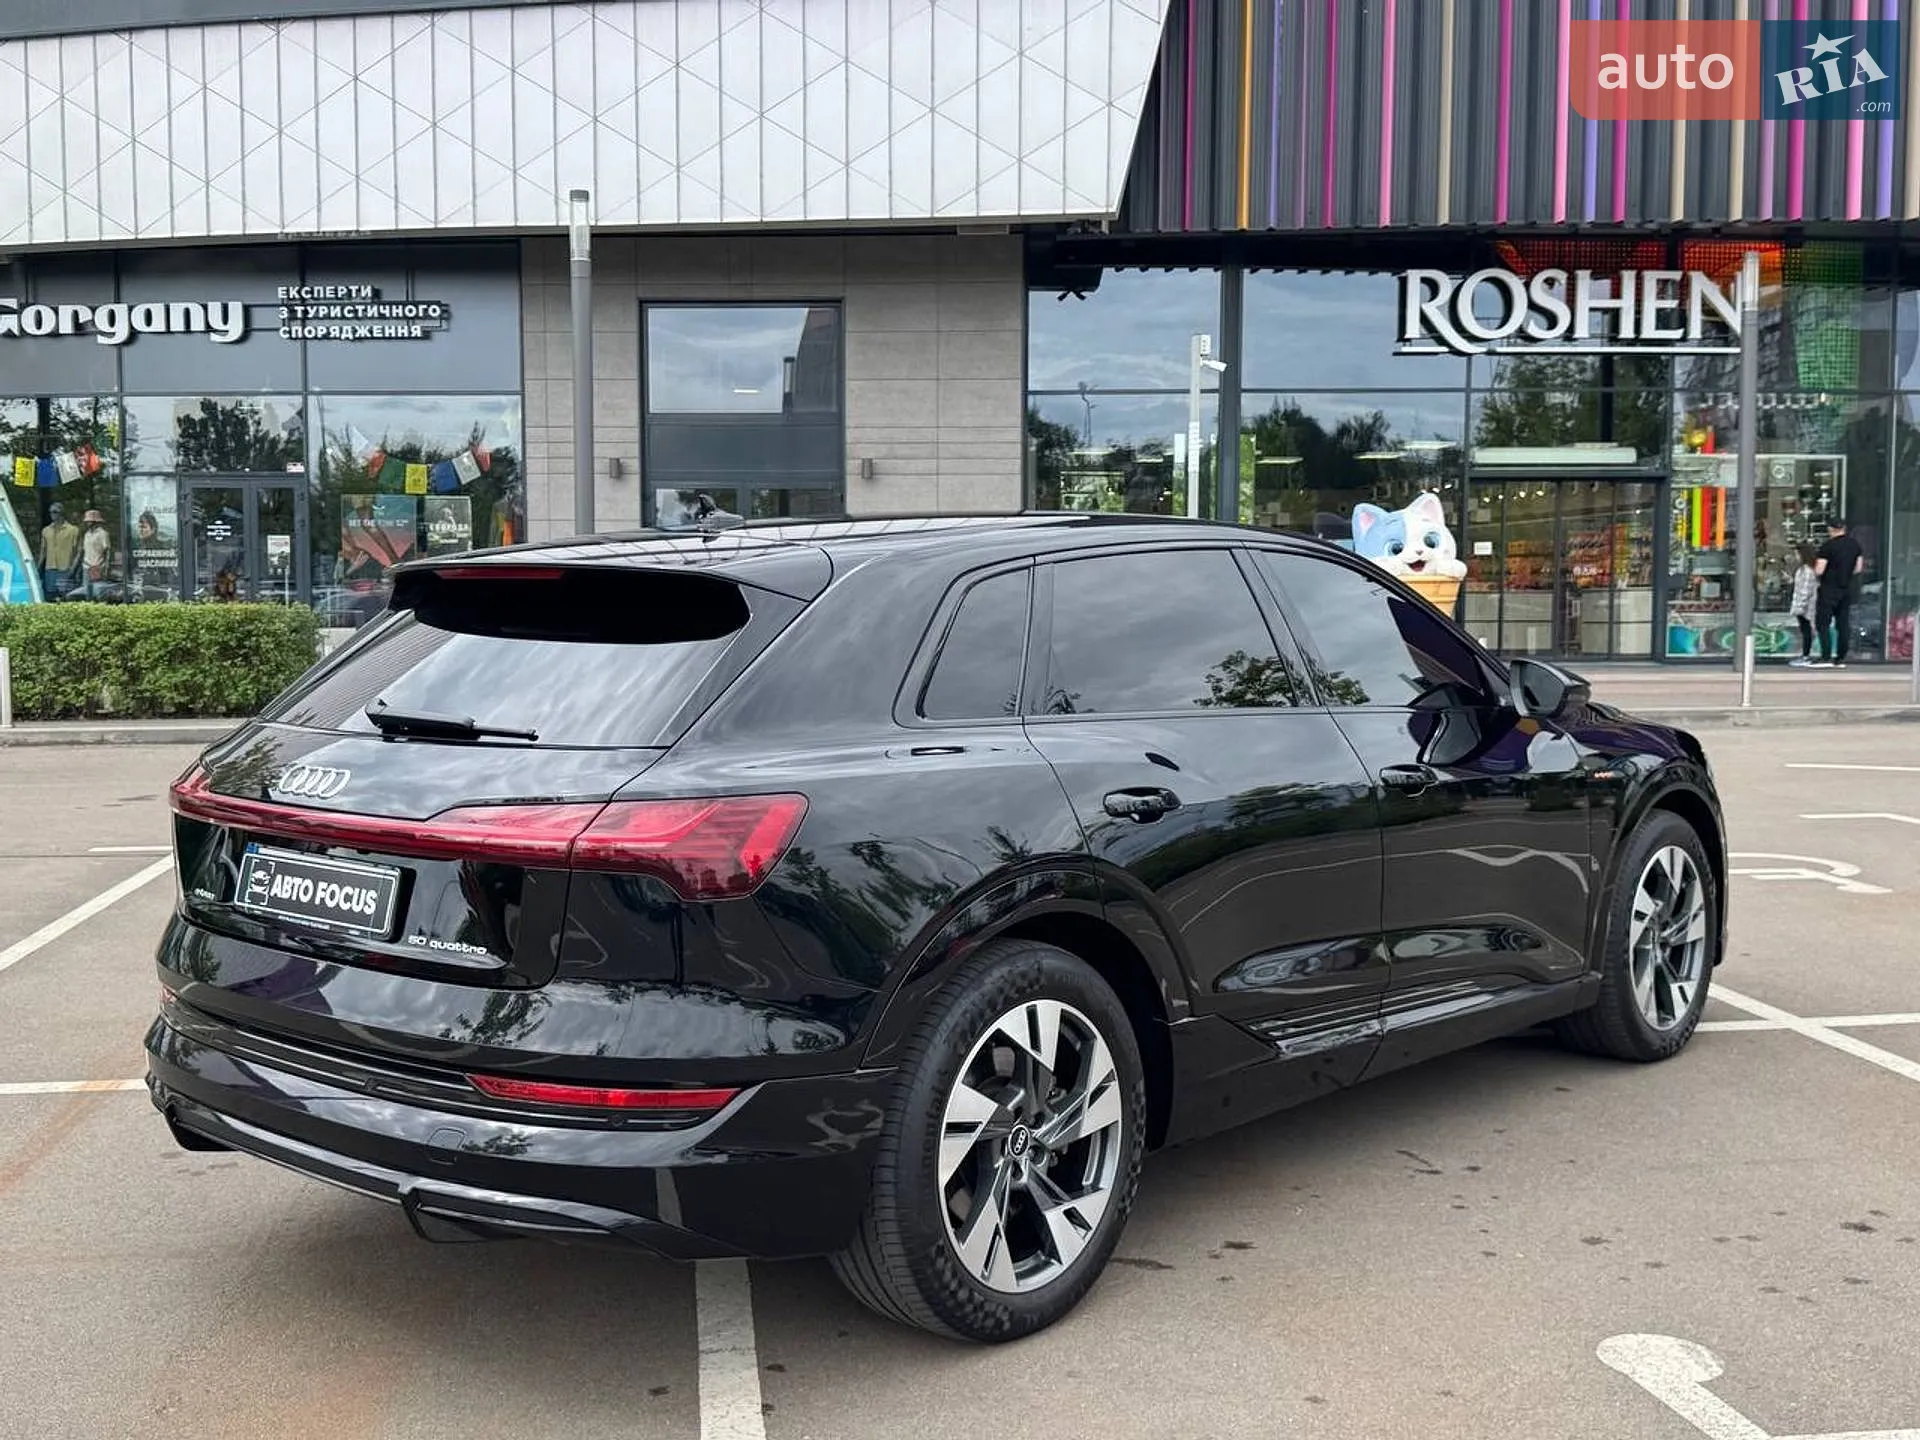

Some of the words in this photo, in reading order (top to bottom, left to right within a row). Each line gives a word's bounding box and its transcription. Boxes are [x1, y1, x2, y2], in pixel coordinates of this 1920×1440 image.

[277, 285, 373, 299] ЕКСПЕРТИ
[294, 304, 441, 318] ТУРИСТИЧНОГО
[1404, 267, 1743, 353] ROSHEN
[278, 324, 422, 340] СПОРЯДЖЕННЯ
[314, 881, 379, 915] FOCUS
[429, 940, 488, 955] quattro
